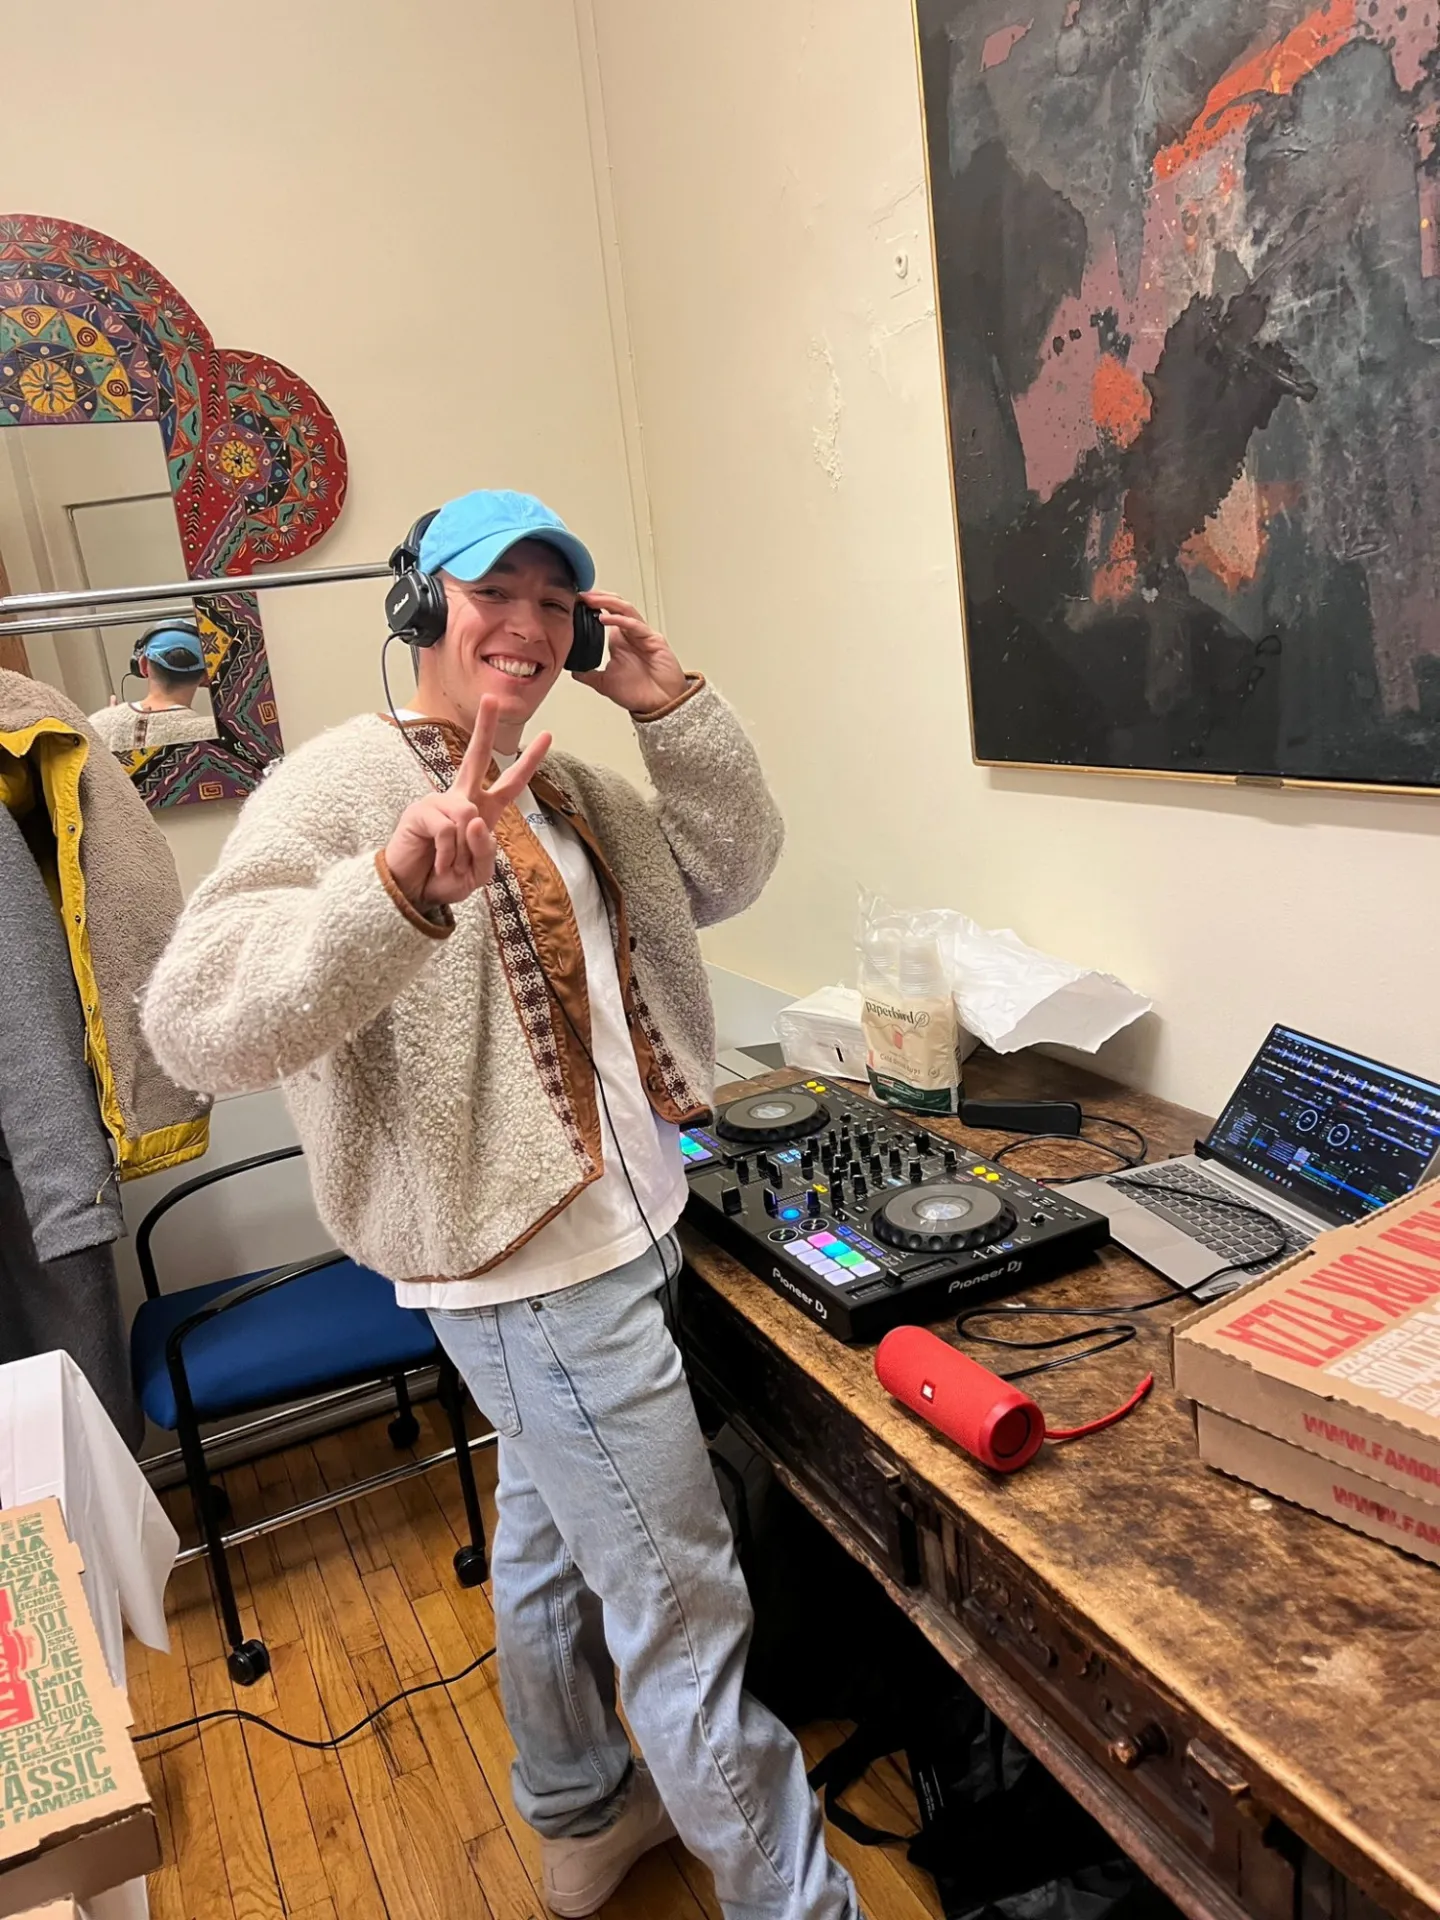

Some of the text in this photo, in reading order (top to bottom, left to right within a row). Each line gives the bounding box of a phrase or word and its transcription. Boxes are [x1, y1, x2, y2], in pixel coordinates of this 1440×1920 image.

[865, 1001, 914, 1024] paperbird
[772, 1267, 813, 1304] Pioneer
[948, 1267, 1004, 1293] Pioneer
[1215, 1288, 1386, 1367] PIZZA
[17, 1713, 101, 1753] PIZZA
[18, 1727, 104, 1763] DELICIOUS
[0, 1745, 112, 1812] ASSIC
[12, 1776, 118, 1824] FAMIGLIA
